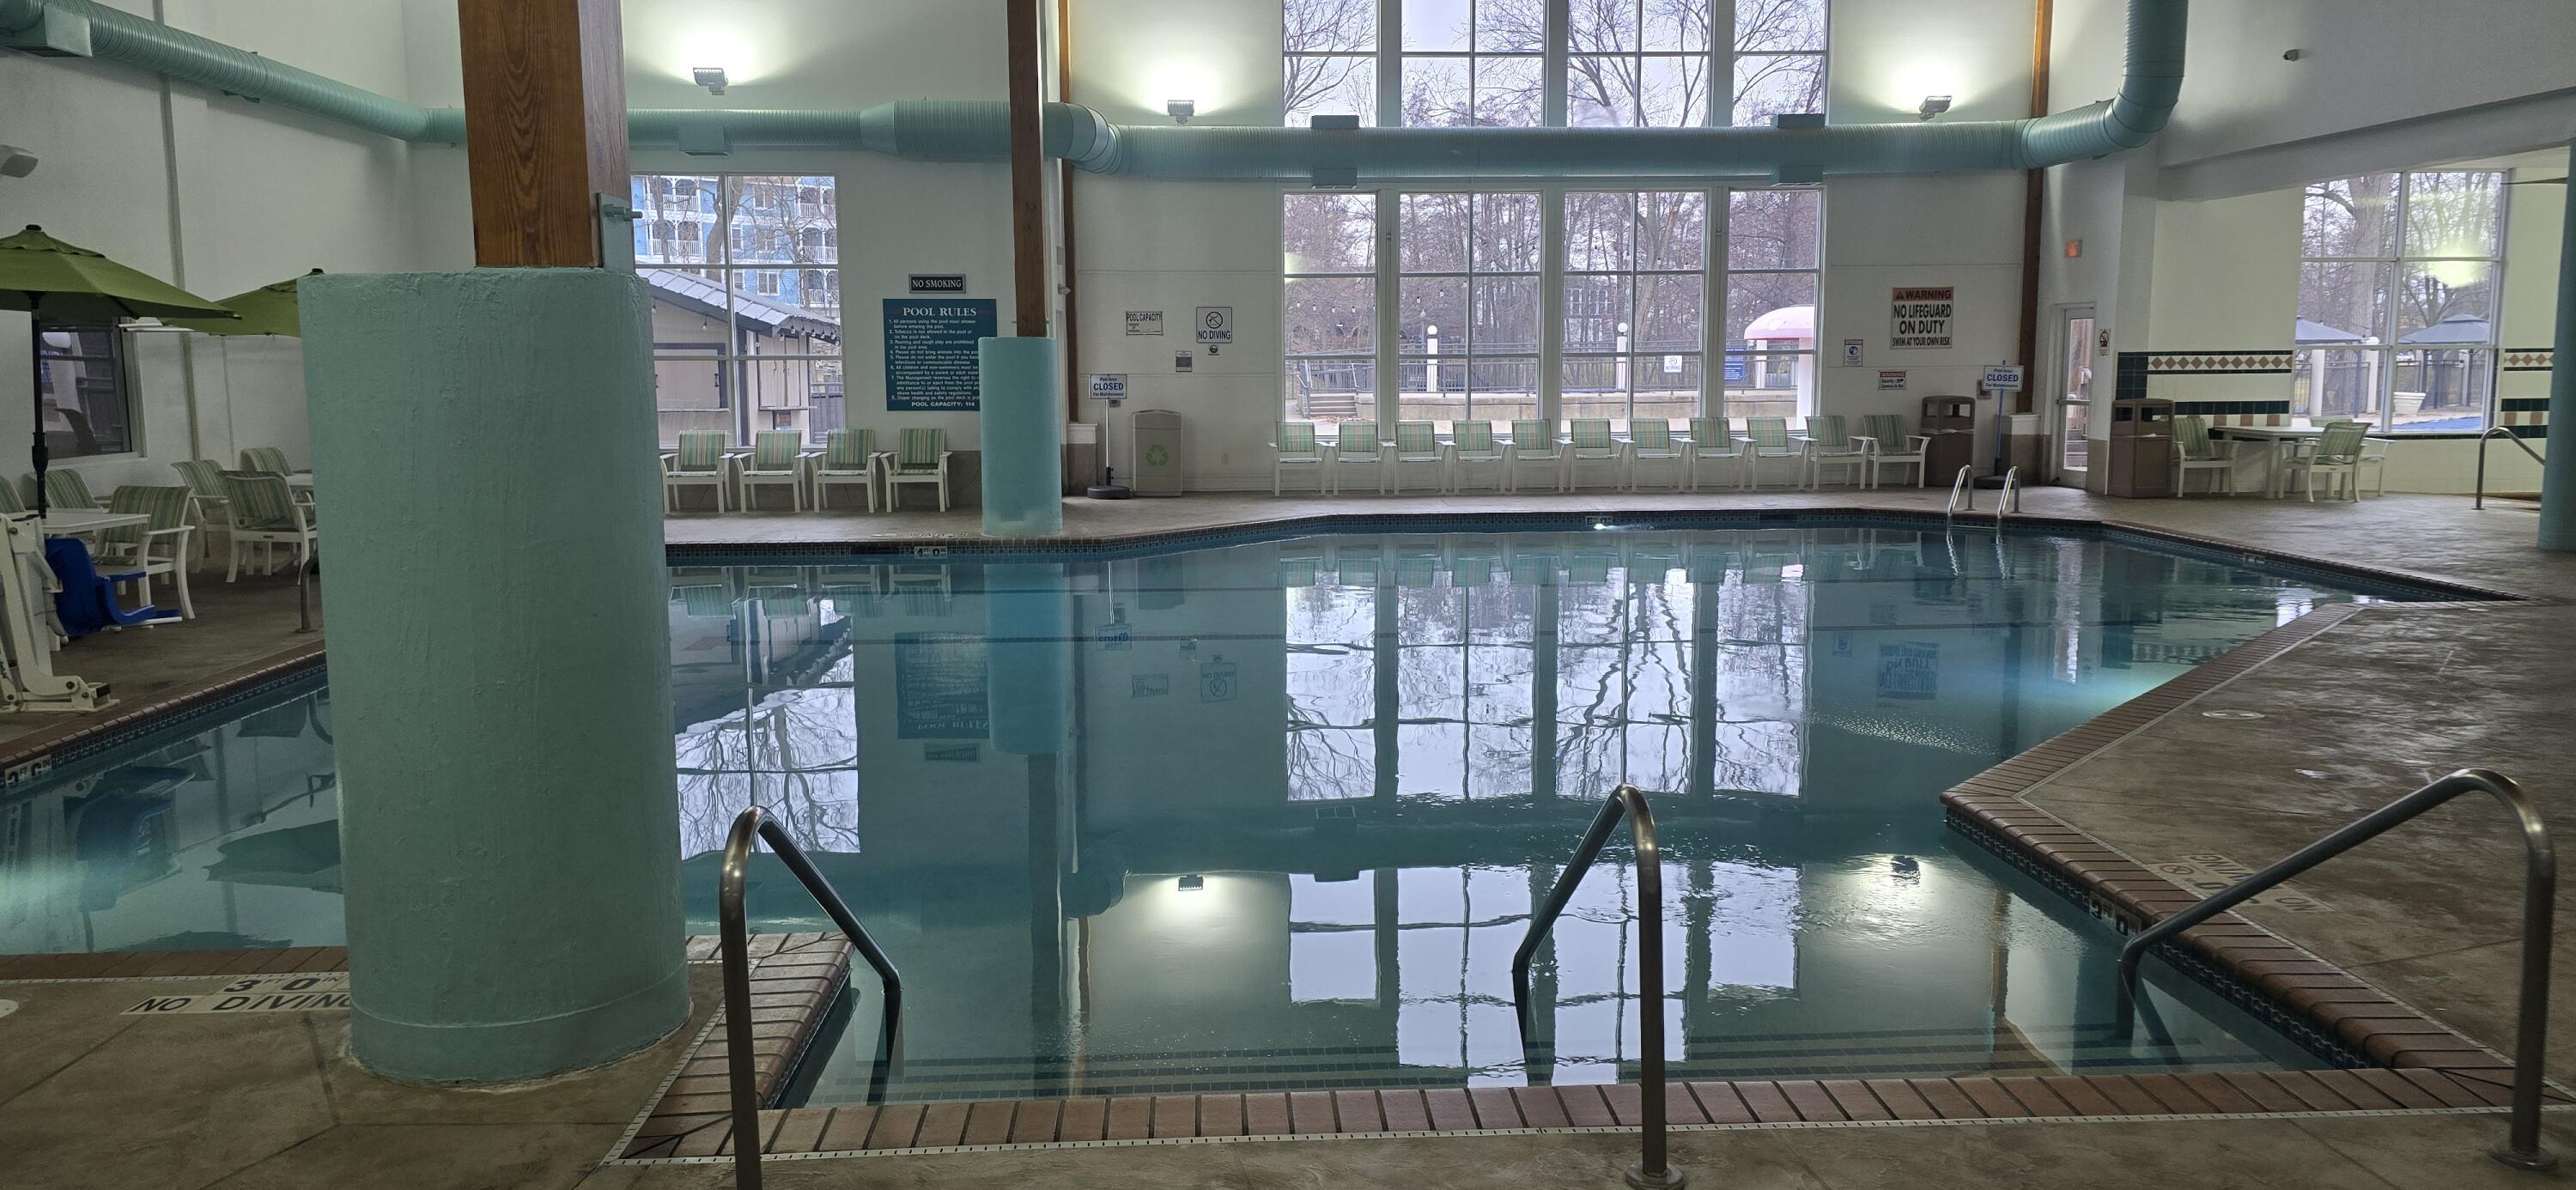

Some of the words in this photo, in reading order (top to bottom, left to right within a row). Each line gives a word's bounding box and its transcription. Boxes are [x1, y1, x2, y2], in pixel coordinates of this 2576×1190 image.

[1905, 290, 1951, 299] WARNING
[903, 307, 935, 316] POOL
[939, 307, 977, 316] RULES
[1894, 304, 1906, 319] NO
[1909, 304, 1951, 319] LIFEGUARD
[1139, 313, 1161, 321] CAPACITY
[1899, 320, 1916, 334] ON
[1919, 319, 1945, 334] DUTY
[1199, 331, 1207, 339] NO
[1209, 331, 1230, 340] DIVING
[1893, 337, 1905, 347] SWIM
[1905, 337, 1913, 346] AT
[1913, 337, 1926, 346] YOUR
[1927, 337, 1939, 346] OWN
[1940, 337, 1950, 345] RISK
[224, 980, 262, 993] 3
[281, 978, 321, 990] 0
[128, 998, 191, 1012] NO
